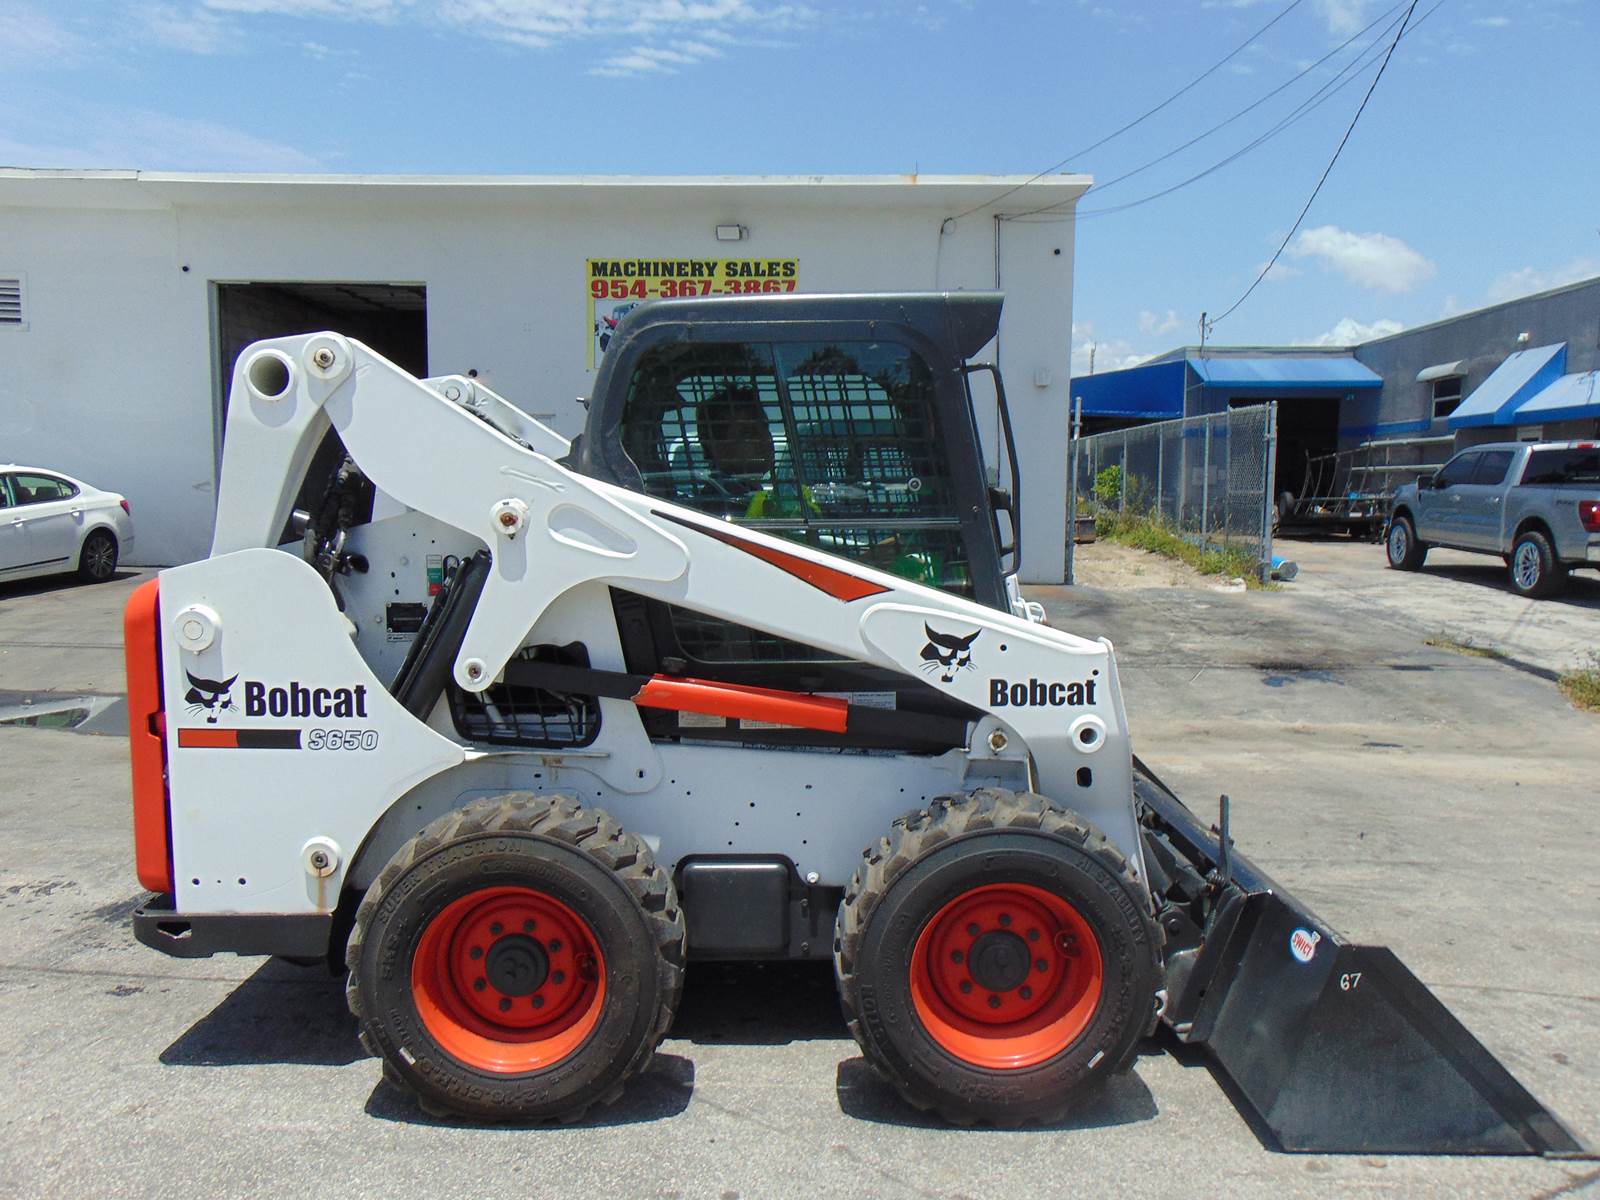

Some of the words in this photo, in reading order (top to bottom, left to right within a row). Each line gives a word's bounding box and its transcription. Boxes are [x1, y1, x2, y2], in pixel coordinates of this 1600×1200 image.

[591, 261, 718, 277] MACHINERY
[725, 261, 796, 277] SALES
[591, 279, 796, 299] 954-367-3867
[245, 681, 368, 718] Bobcat
[989, 678, 1096, 707] Bobcat
[308, 728, 379, 751] S650
[1340, 973, 1362, 991] 67
